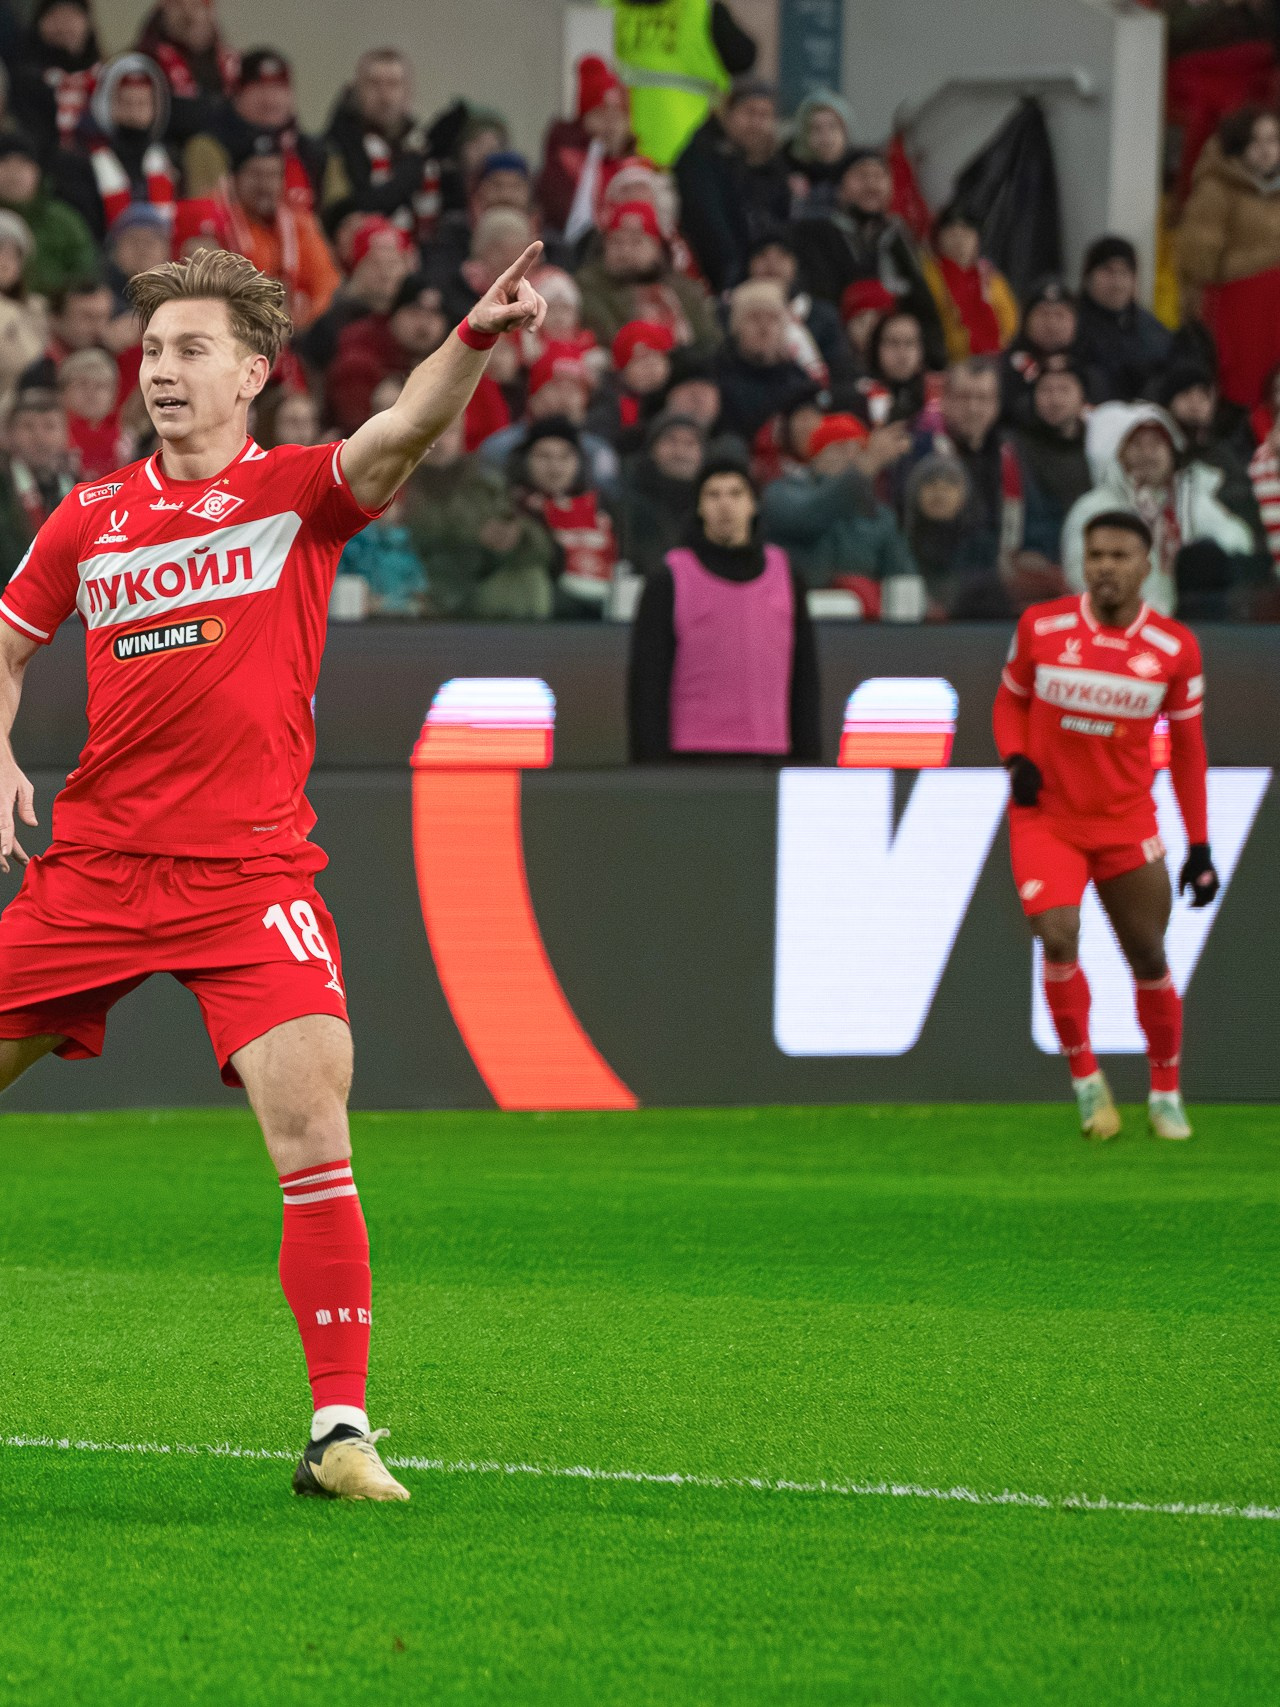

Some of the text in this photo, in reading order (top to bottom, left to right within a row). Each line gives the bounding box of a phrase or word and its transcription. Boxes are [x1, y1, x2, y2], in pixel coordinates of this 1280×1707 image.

[85, 546, 253, 614] ЛУКОЙЛ
[117, 624, 198, 657] WINLINE
[261, 900, 332, 962] 18
